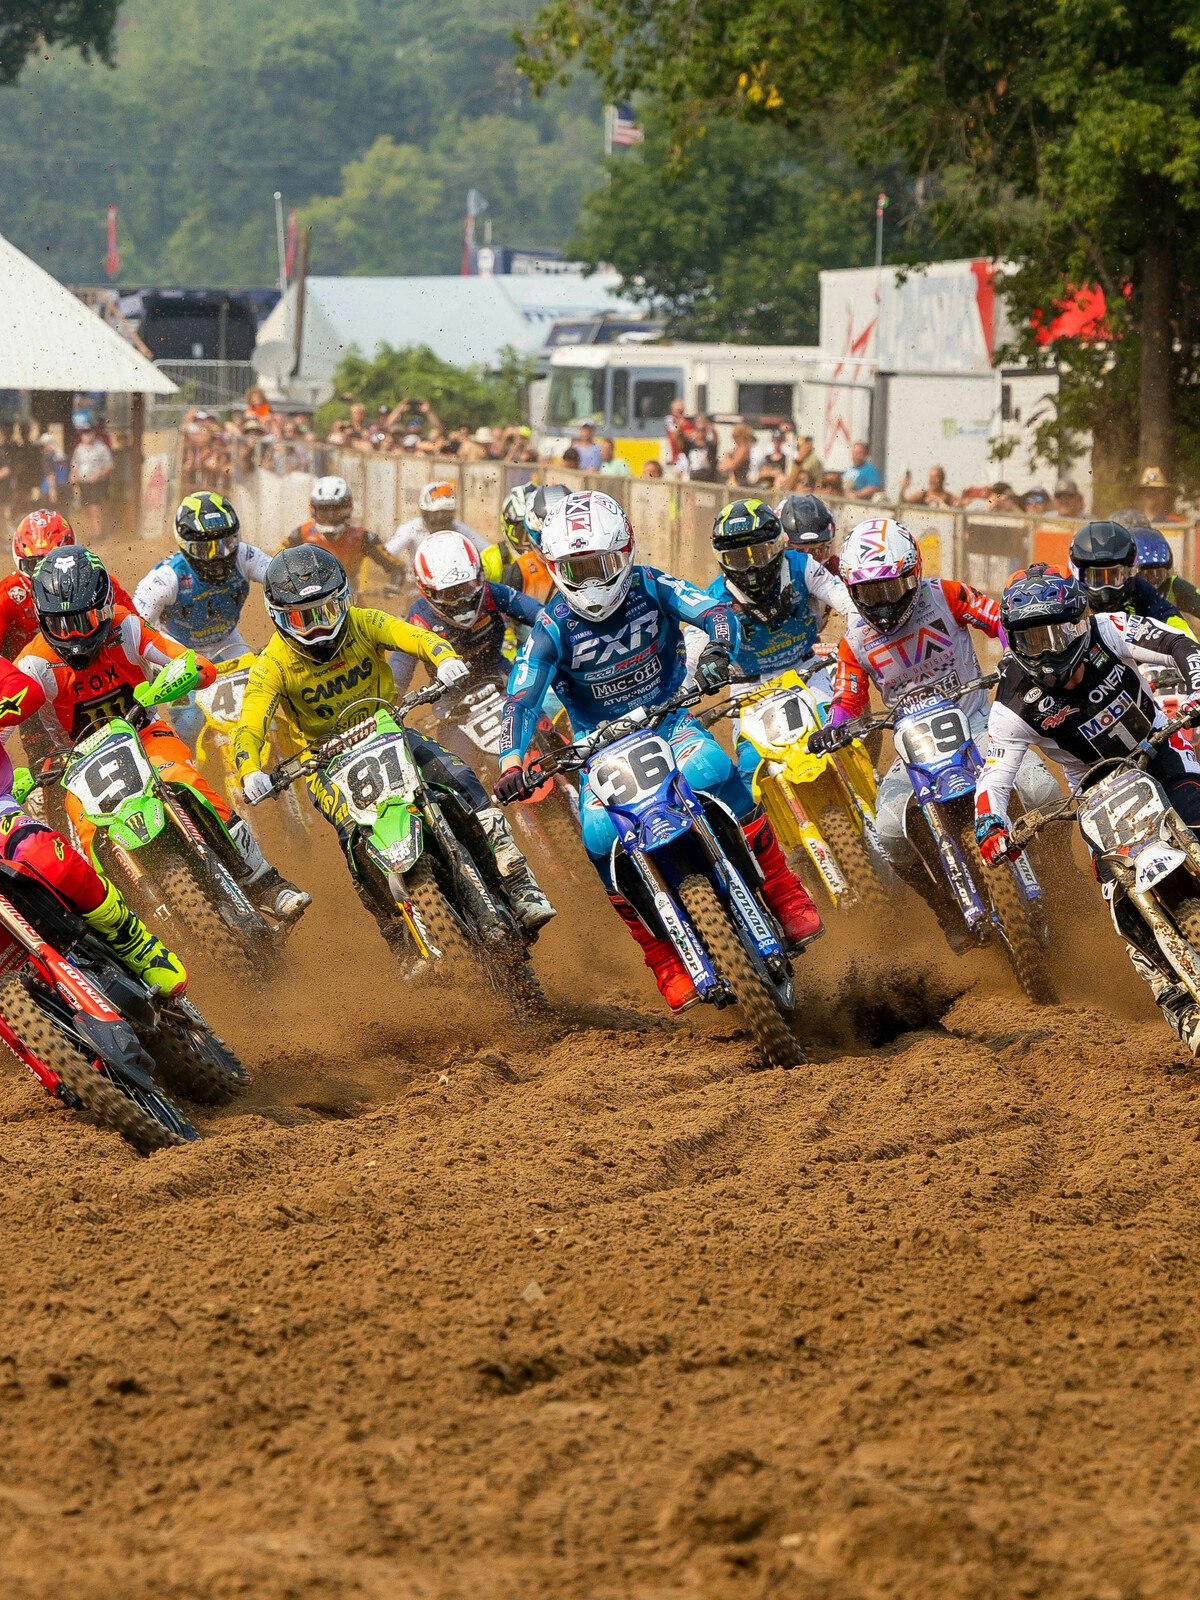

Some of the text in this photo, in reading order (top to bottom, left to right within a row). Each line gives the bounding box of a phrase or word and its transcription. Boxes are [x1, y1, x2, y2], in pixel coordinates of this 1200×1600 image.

[302, 587, 319, 595] BELL
[571, 610, 659, 669] FXR
[574, 630, 593, 640] YAMAHA
[72, 665, 120, 697] FOX
[301, 658, 373, 704] CANVAS
[596, 659, 658, 697] Muc-Off
[637, 676, 661, 695] MORE
[1028, 689, 1040, 700] Arai
[903, 697, 937, 715] Mika
[1080, 692, 1133, 739] Mobil
[1108, 721, 1138, 750] 1
[85, 745, 144, 814] 9
[347, 746, 404, 810] 81
[597, 741, 671, 805] 36
[1090, 781, 1160, 851] 12
[1017, 856, 1034, 881] DUN
[1139, 856, 1173, 882] Mobil
[730, 879, 767, 936] DUNLOP
[57, 961, 112, 1014] DUNLOP
